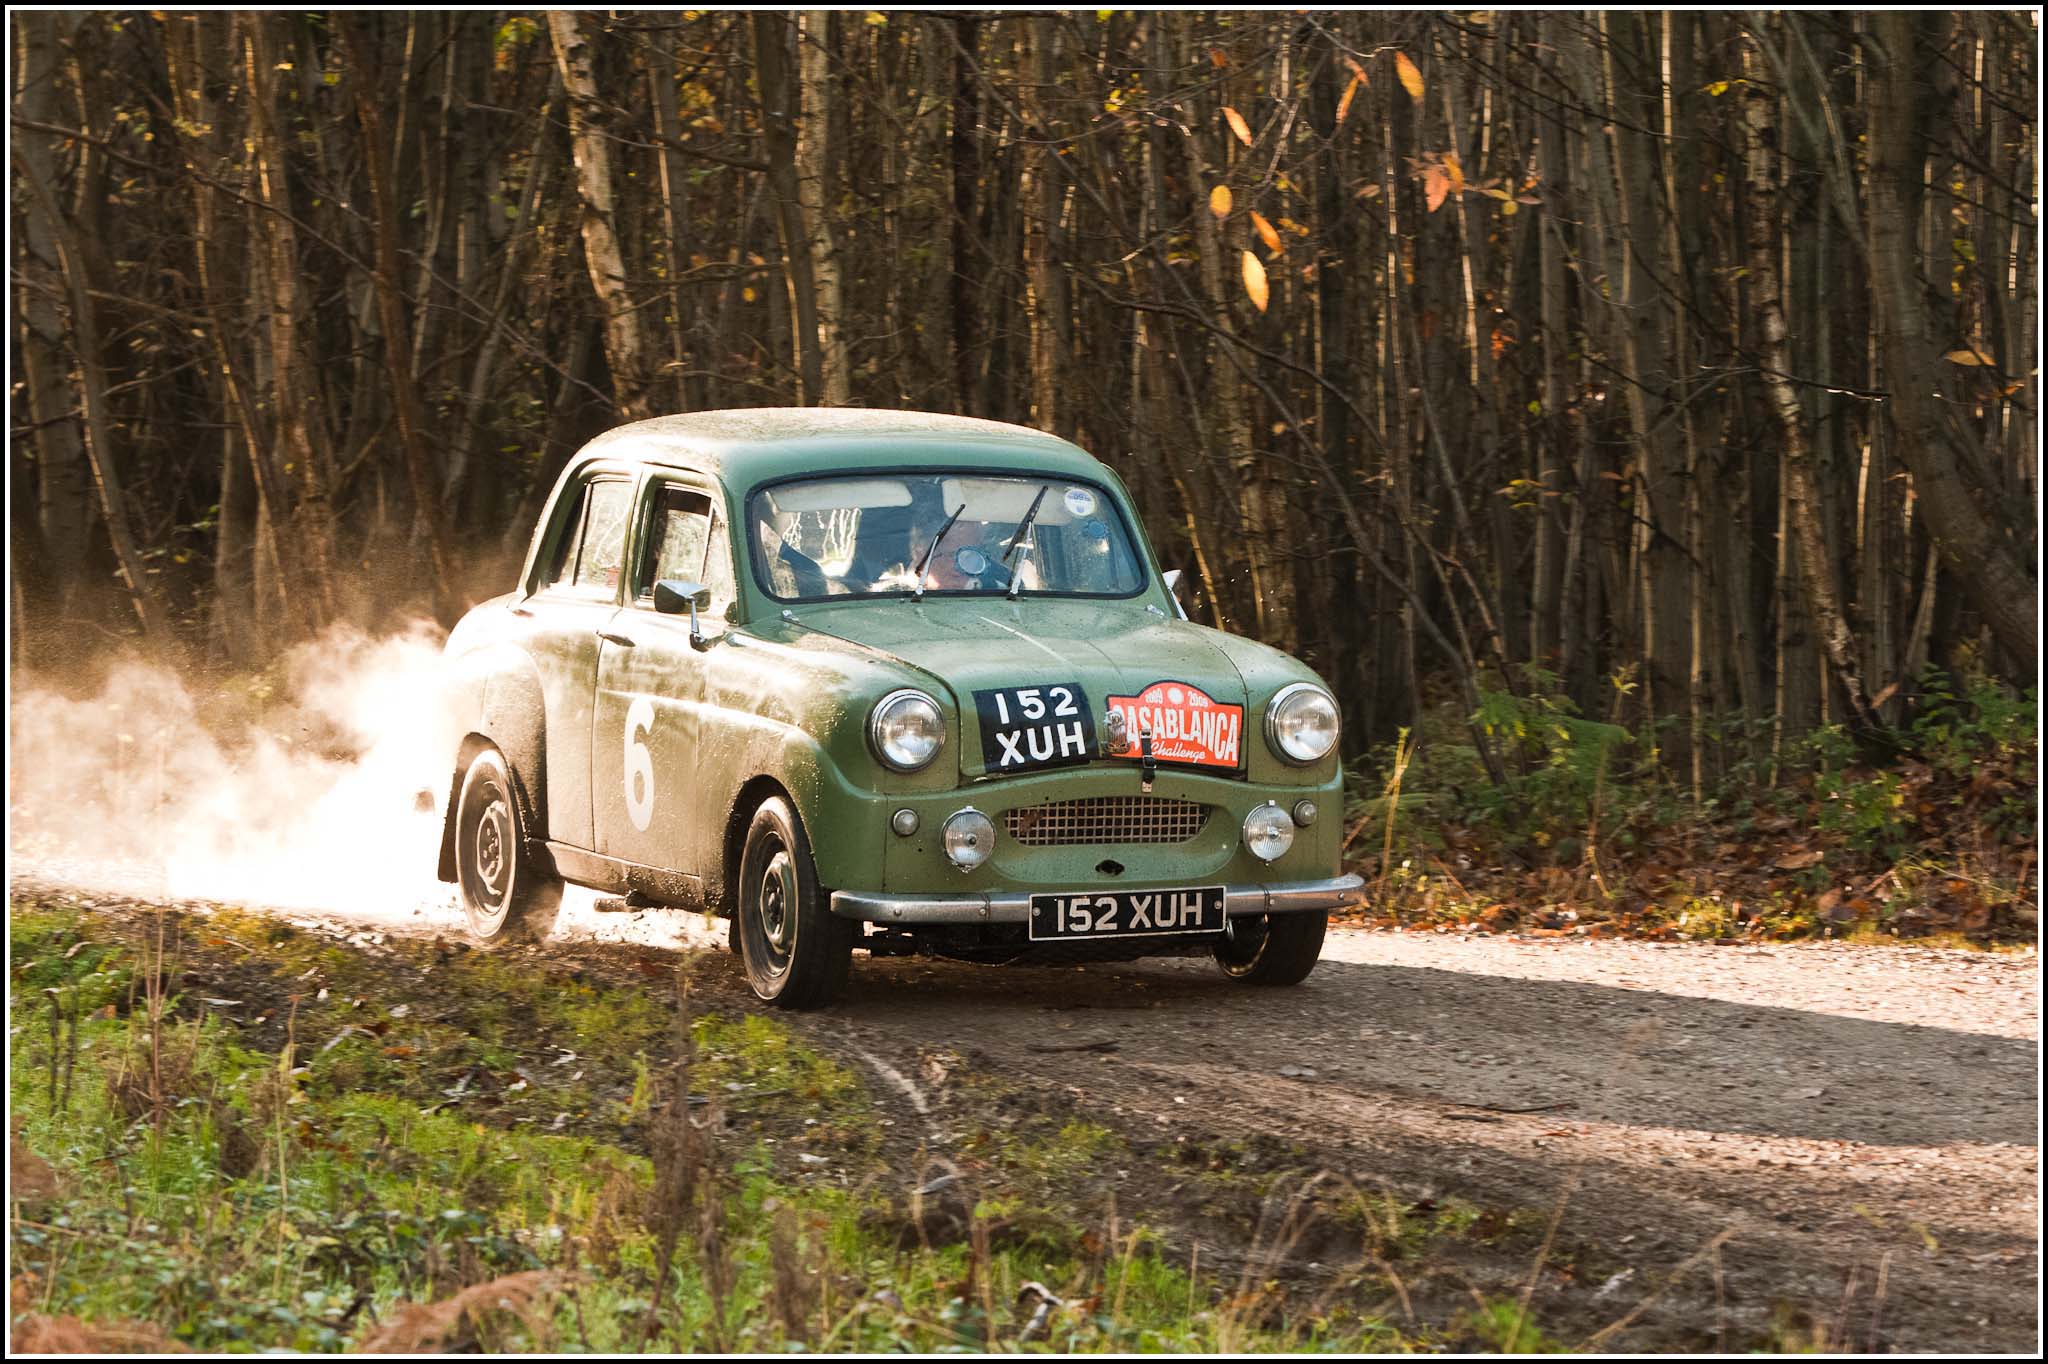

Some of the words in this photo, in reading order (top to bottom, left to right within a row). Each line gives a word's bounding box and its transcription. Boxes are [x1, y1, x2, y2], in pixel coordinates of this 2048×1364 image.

[995, 687, 1078, 724] 152
[996, 721, 1086, 766] XUH
[1151, 741, 1206, 763] Challenge
[624, 696, 654, 832] 6
[1057, 896, 1118, 932] 152
[1129, 893, 1203, 929] XUH
